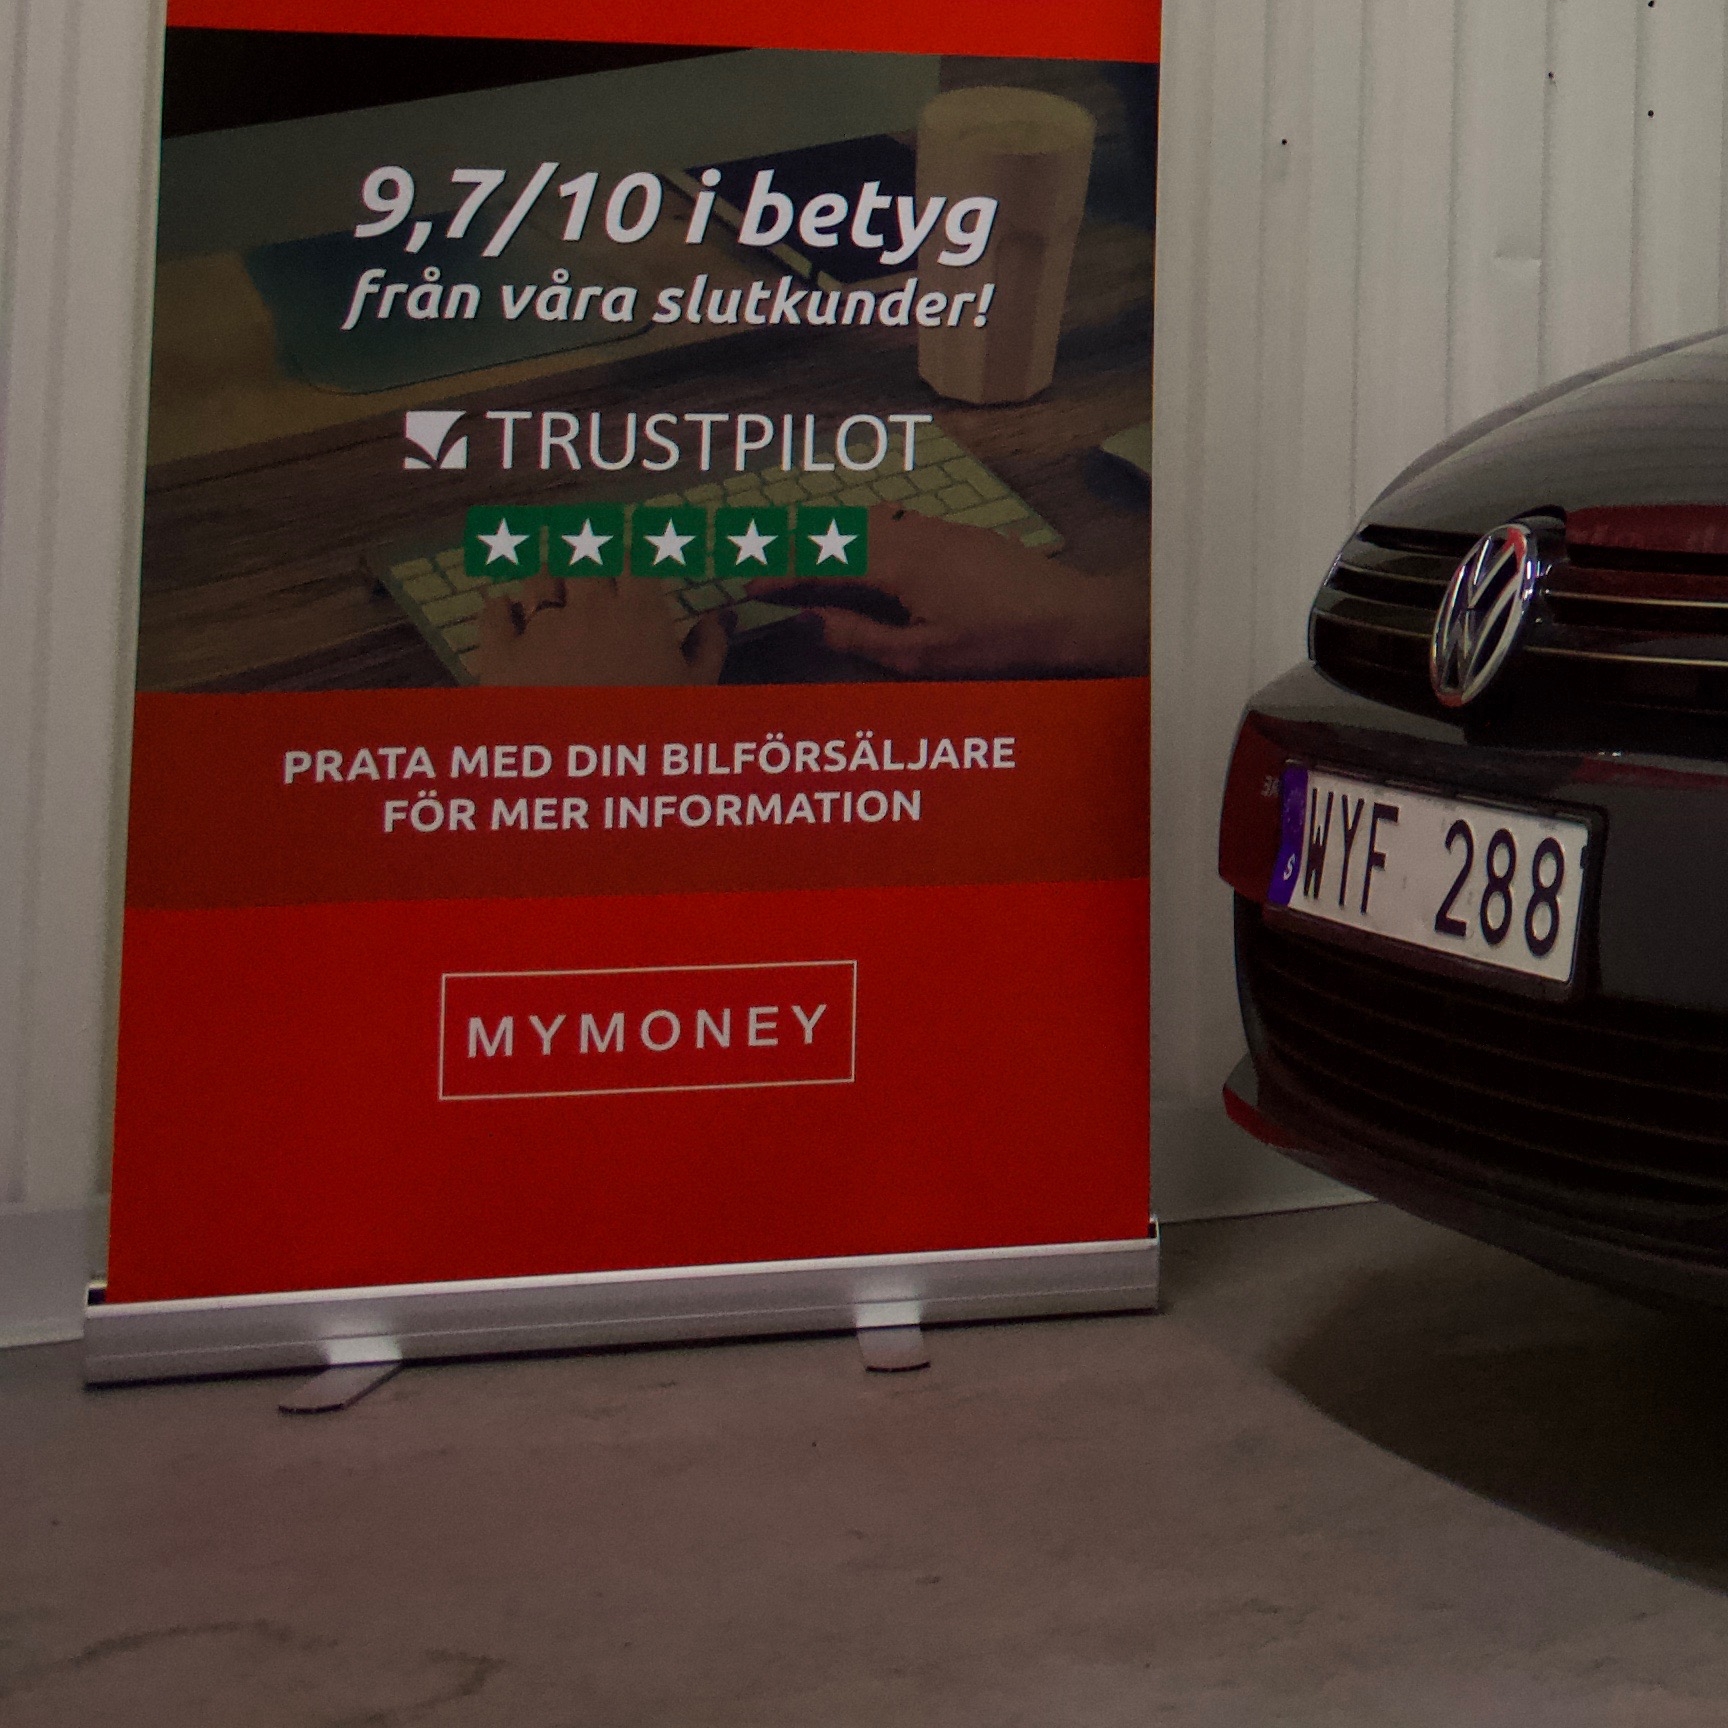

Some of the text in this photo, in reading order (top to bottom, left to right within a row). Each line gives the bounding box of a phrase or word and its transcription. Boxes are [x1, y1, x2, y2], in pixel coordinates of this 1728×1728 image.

[355, 162, 998, 266] 9,7/10 i betyg
[341, 266, 995, 331] från våra slutkunder!
[486, 410, 932, 472] TRUSTPILOT
[283, 730, 1016, 784] PRATA MED DIN BILFÖRSÄLJARE
[382, 789, 921, 833] FÖR MER INFORMATION
[1282, 853, 1297, 881] S
[1302, 786, 1565, 958] WYF 288
[467, 1003, 828, 1059] MYMONEY
